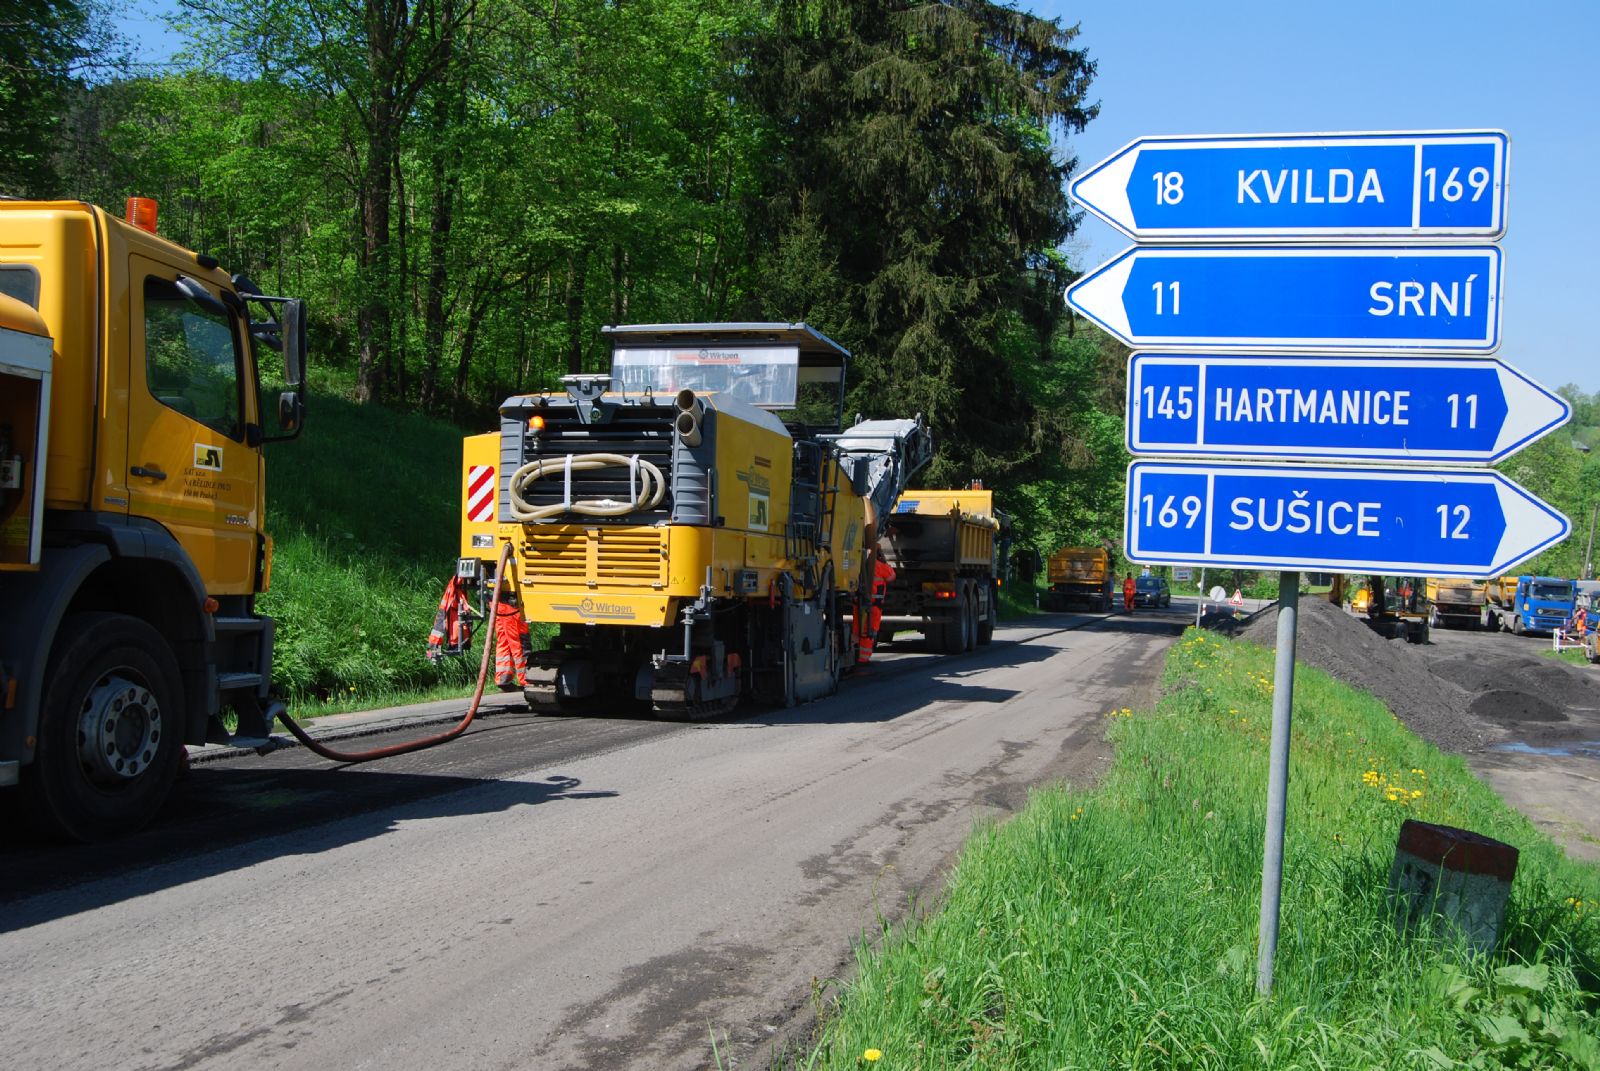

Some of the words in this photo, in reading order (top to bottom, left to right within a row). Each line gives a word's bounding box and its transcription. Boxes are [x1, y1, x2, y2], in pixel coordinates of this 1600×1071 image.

[1153, 172, 1183, 204] 18
[1238, 169, 1384, 203] KVILDA
[1425, 167, 1489, 201] 169
[1153, 282, 1179, 314] 11
[1369, 274, 1477, 316] SRNÍ
[1144, 386, 1192, 419] 145
[1216, 388, 1409, 424] HARTMANICE
[1448, 394, 1477, 428] 11
[1141, 494, 1201, 528] 169
[1230, 491, 1381, 536] SUŠICE
[1437, 505, 1470, 538] 12
[596, 602, 632, 613] Wirtgen
